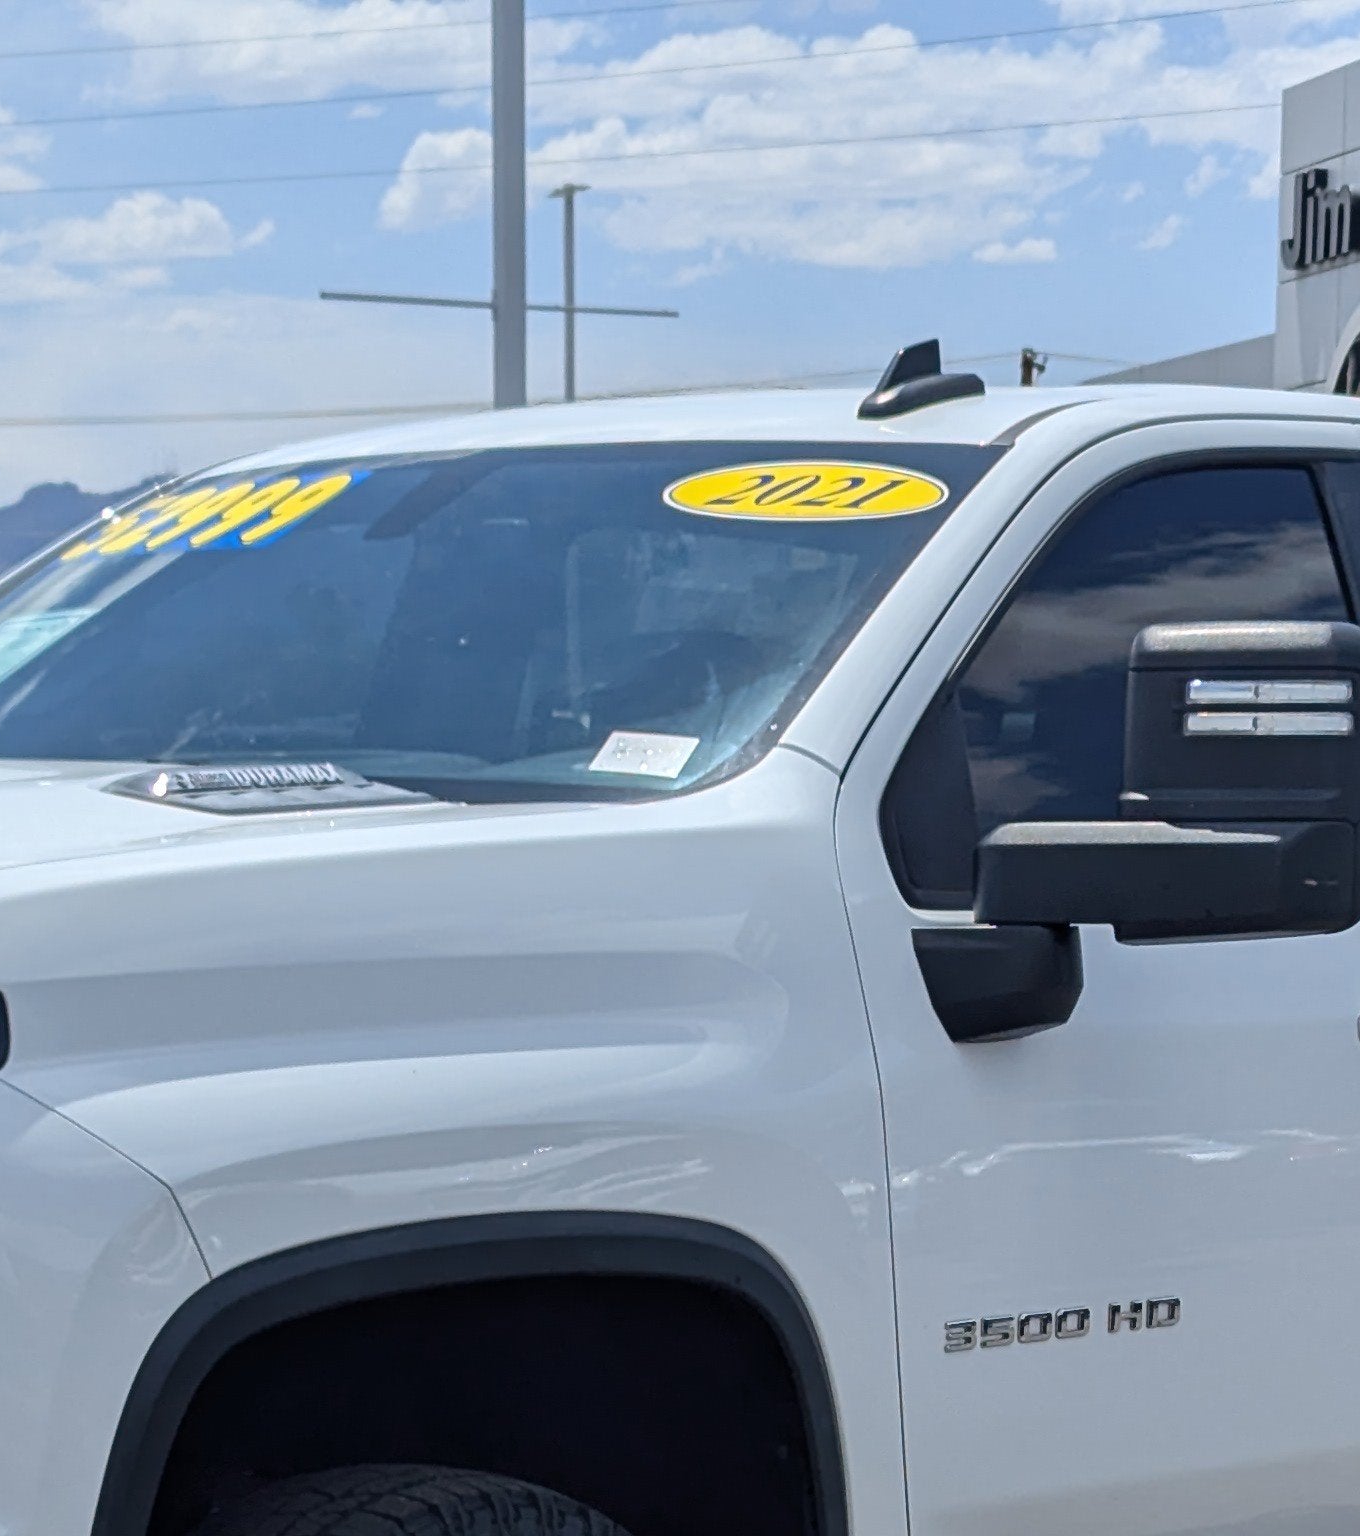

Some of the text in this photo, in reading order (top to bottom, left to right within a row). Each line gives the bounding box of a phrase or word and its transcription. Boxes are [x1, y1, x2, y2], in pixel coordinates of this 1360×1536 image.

[1281, 168, 1353, 270] Jim
[704, 474, 910, 509] 2021
[228, 760, 344, 788] DURAMAX
[944, 1295, 1181, 1354] 3500 HD
